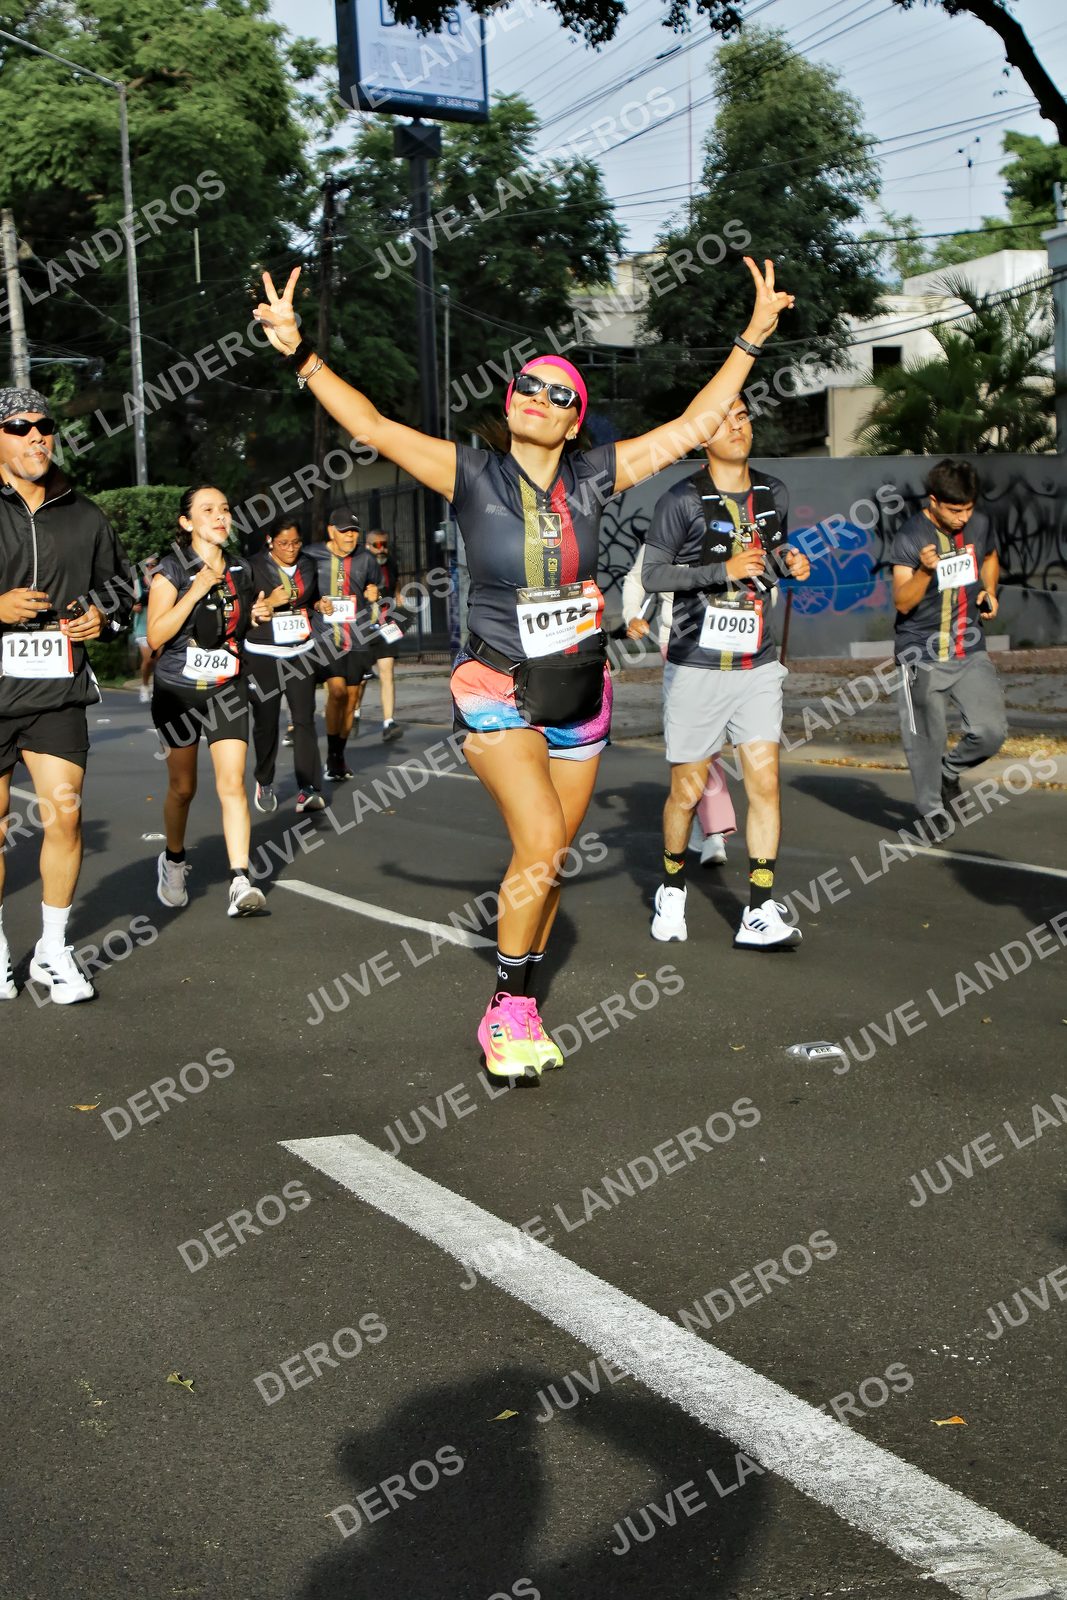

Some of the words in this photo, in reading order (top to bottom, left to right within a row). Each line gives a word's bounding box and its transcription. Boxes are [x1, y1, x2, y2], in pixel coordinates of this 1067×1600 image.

[940, 558, 971, 577] 10179
[276, 619, 306, 631] 12376
[708, 614, 755, 634] 10903
[7, 638, 62, 657] 12191
[194, 653, 229, 670] 8784
